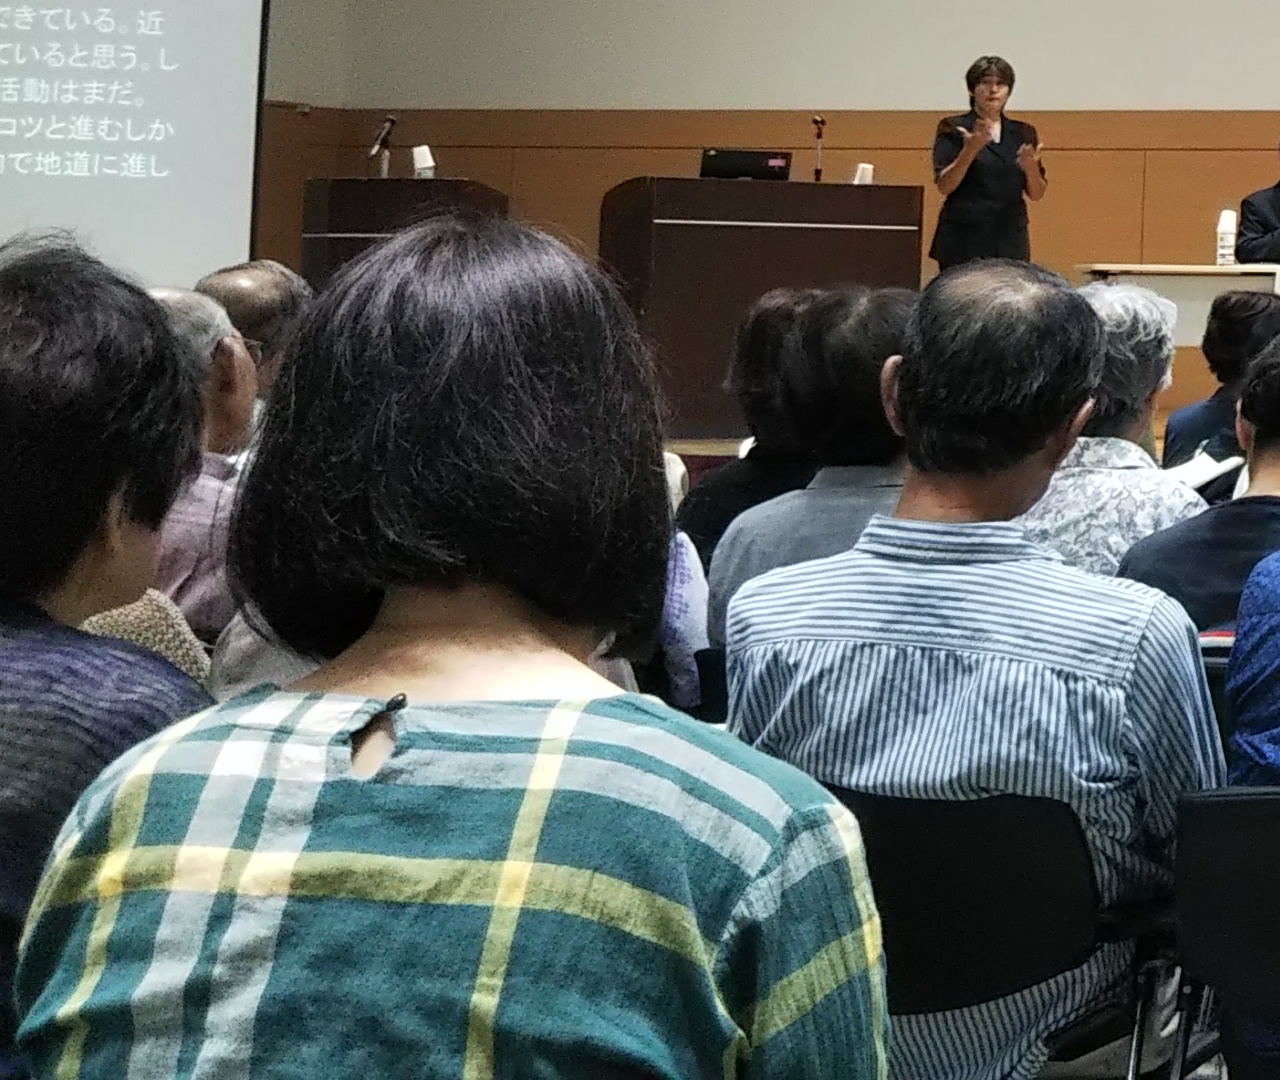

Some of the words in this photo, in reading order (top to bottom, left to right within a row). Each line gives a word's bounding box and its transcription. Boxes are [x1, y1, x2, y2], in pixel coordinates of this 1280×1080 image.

[0, 151, 170, 177] で地道に進し
